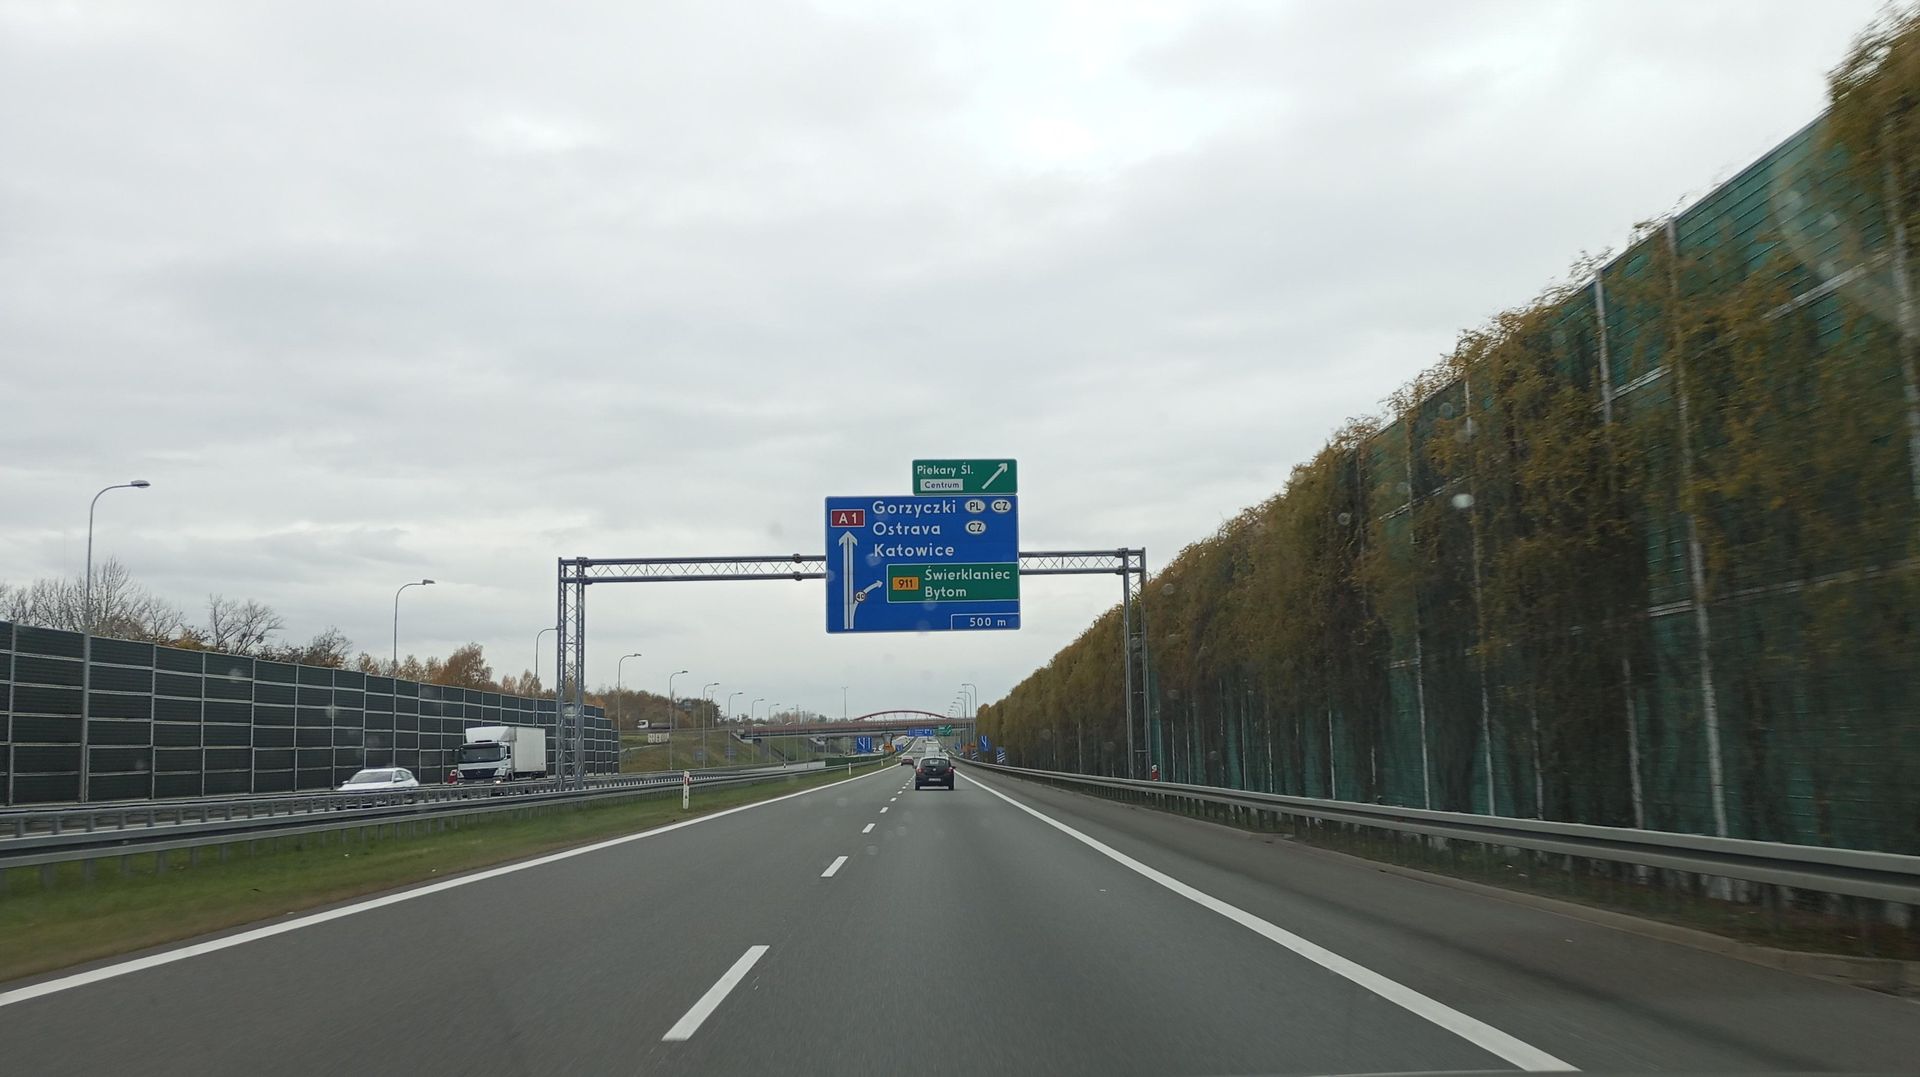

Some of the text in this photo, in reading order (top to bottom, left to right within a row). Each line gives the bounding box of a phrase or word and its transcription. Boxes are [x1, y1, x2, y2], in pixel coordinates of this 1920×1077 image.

[917, 461, 974, 478] Piekary Śl.
[924, 481, 960, 489] Centrum
[872, 500, 1008, 517] Gorzyczki PL CZ
[872, 521, 982, 536] Ostrava CZ
[874, 543, 954, 557] Katowice
[924, 566, 1010, 581] Świerklaniec
[898, 579, 913, 588] 911
[924, 586, 967, 600] Bytom
[969, 617, 1006, 627] 500 m
